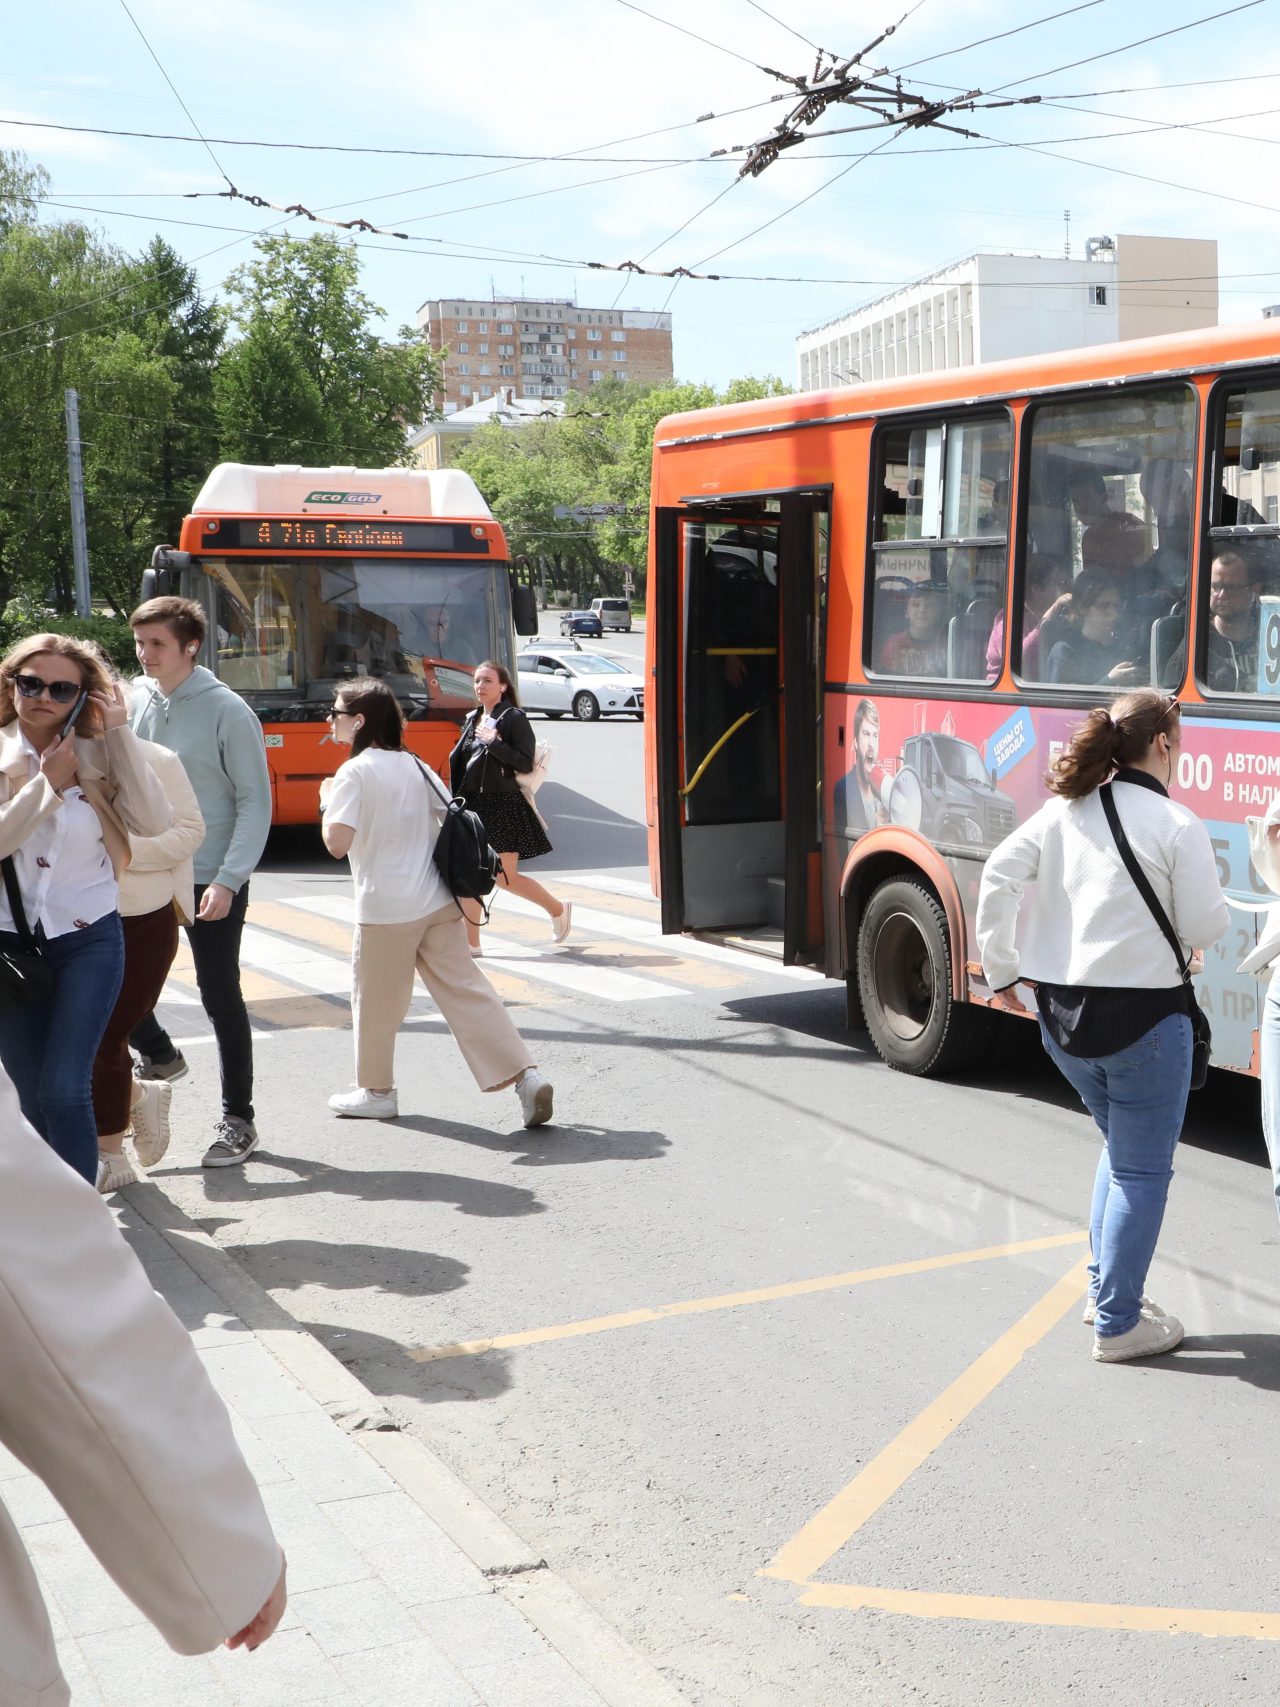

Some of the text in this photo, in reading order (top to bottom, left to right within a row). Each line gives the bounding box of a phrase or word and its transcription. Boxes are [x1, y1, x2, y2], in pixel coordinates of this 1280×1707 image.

[993, 719, 1025, 757] ЦЕНЫ ОТ
[996, 734, 1026, 768] ЗАВОДА
[1176, 752, 1213, 792] 00
[1223, 782, 1234, 801] В
